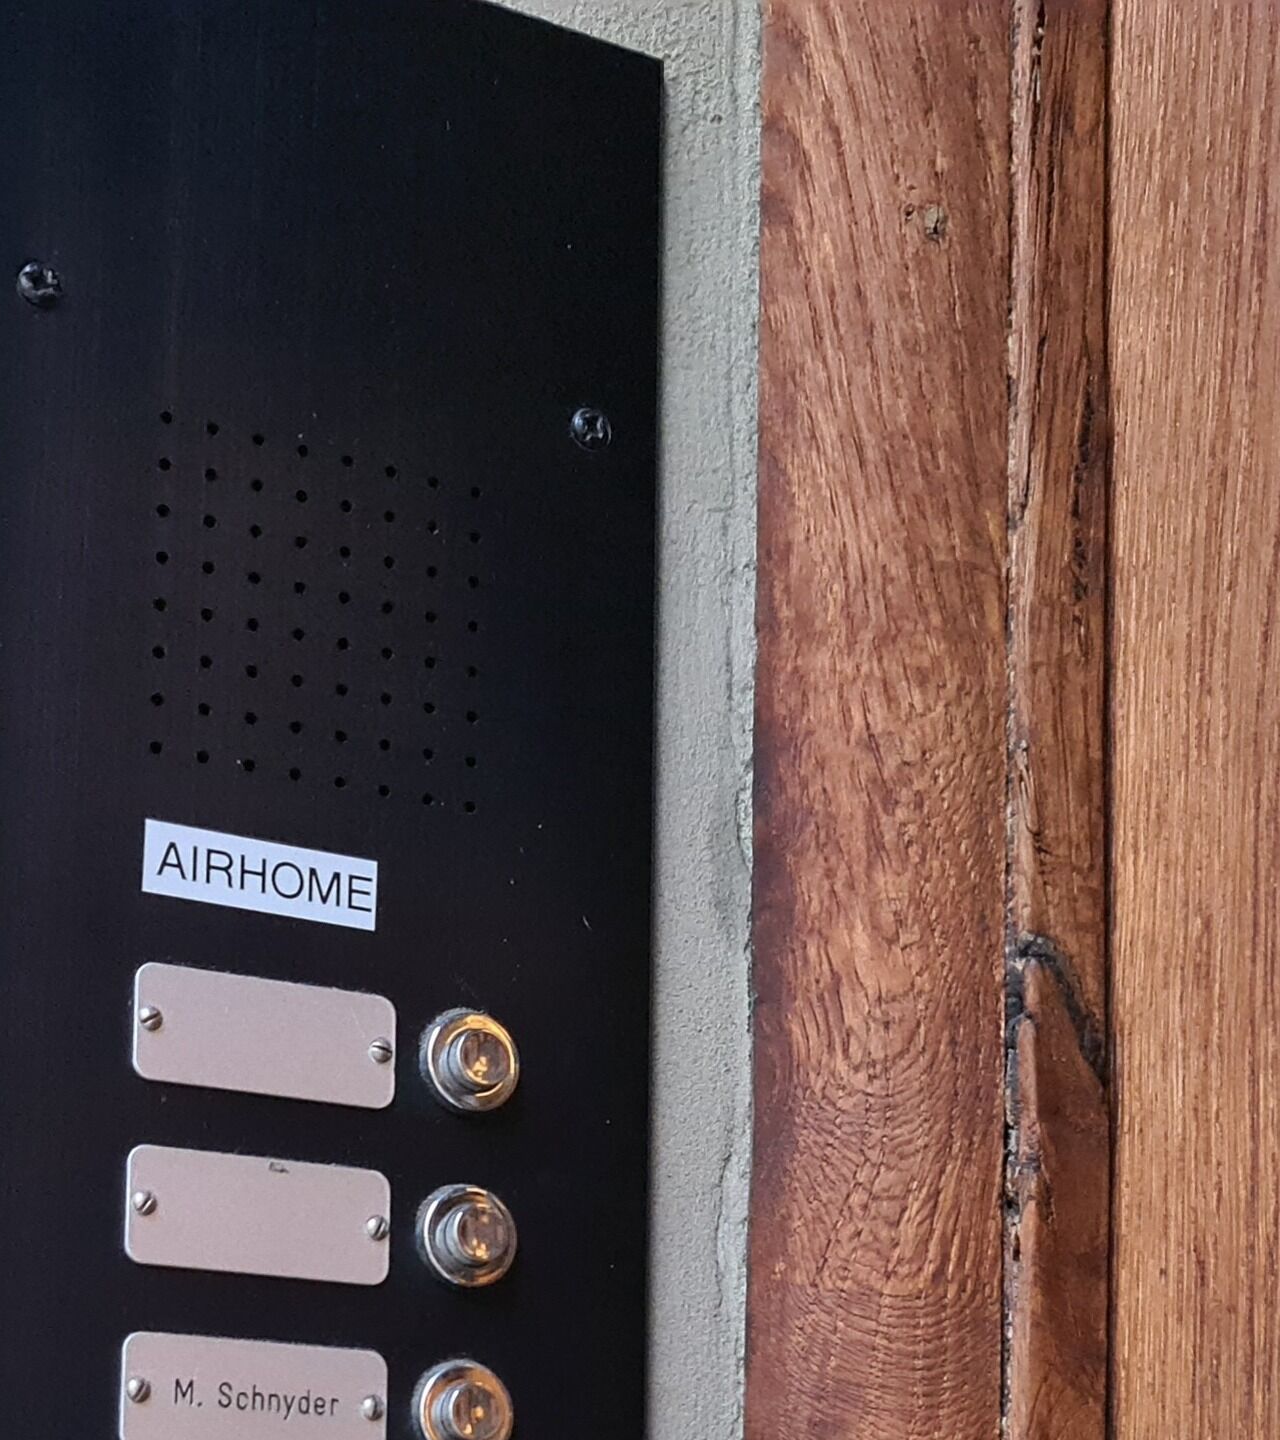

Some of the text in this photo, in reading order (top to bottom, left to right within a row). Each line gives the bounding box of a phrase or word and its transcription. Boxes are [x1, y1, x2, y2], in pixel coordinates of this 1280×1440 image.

[157, 841, 373, 913] AIRHOME
[173, 1377, 340, 1421] M. Schnyder
